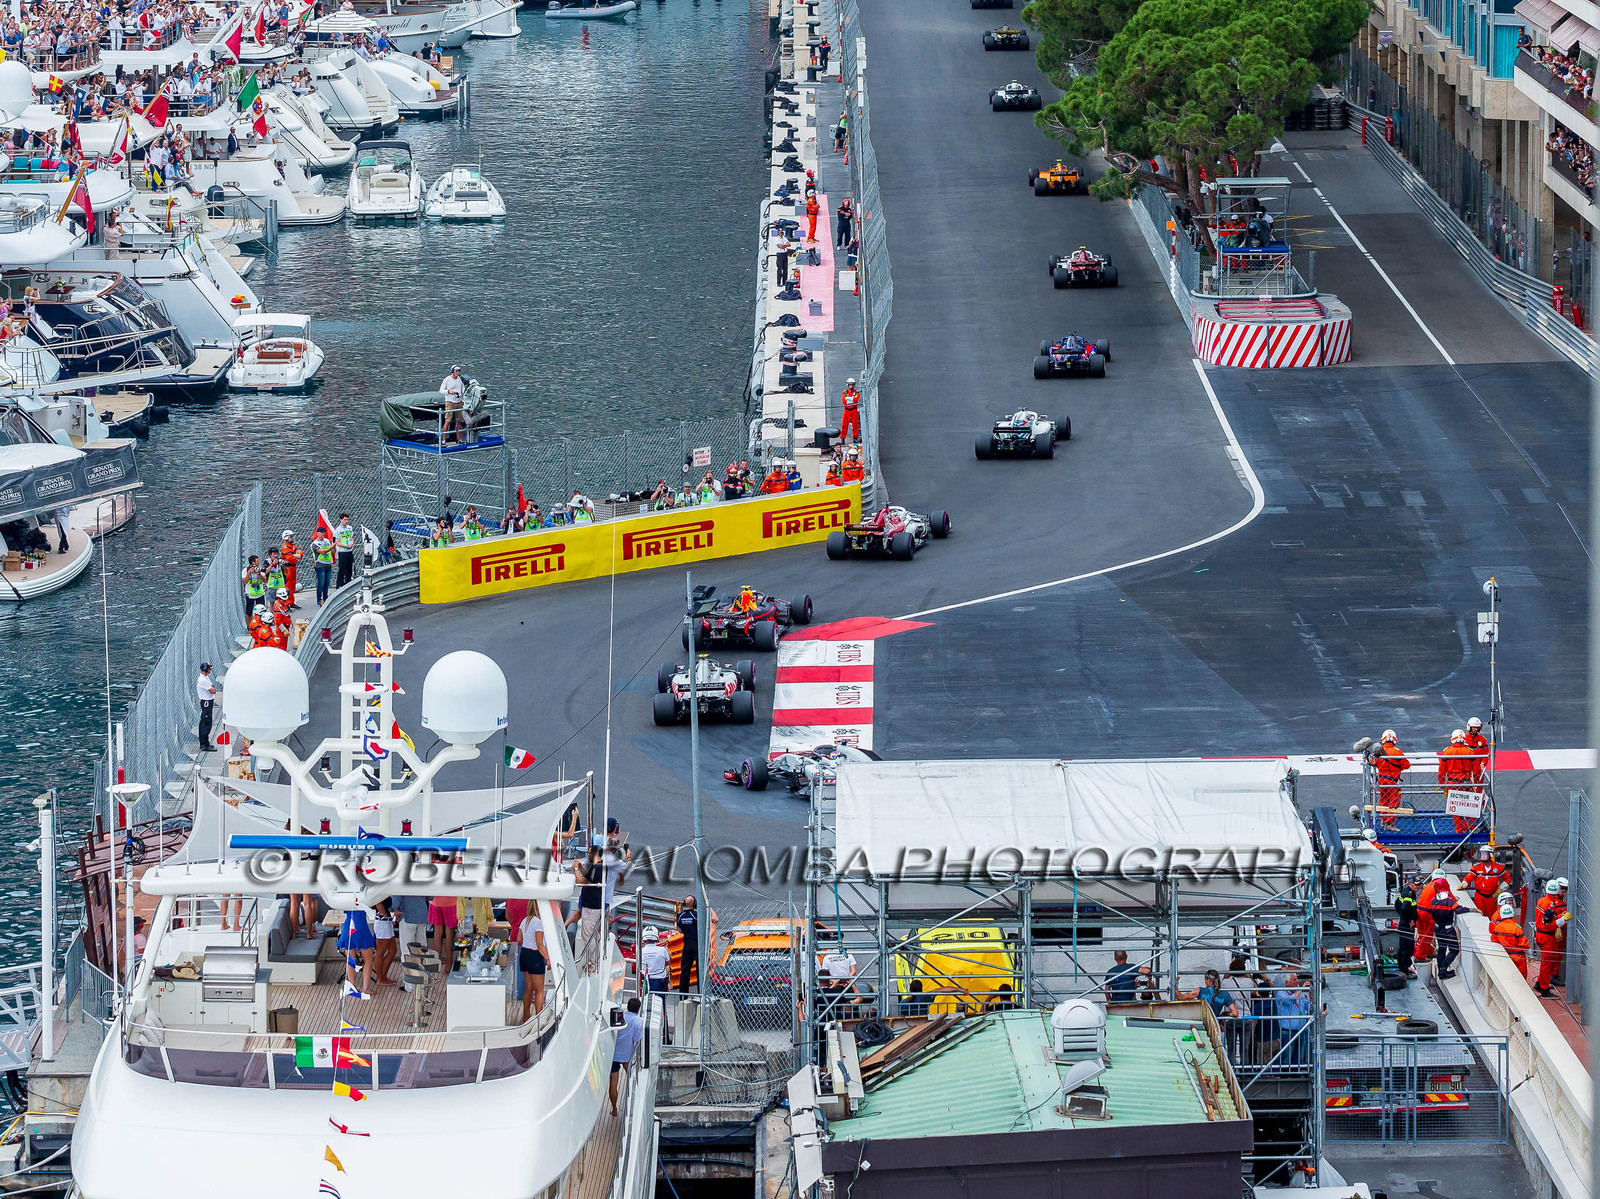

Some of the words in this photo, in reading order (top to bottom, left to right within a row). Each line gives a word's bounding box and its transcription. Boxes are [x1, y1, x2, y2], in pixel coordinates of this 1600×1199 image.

[87, 469, 106, 480] GRAND
[105, 466, 122, 476] PRIX
[92, 462, 114, 474] SENATE
[37, 482, 57, 493] GRAND
[56, 479, 72, 489] PRIX
[42, 475, 64, 486] SENATE
[7, 490, 21, 500] PRIX
[762, 499, 851, 539] PIRELLI
[622, 519, 715, 561] PIRELLI
[471, 543, 566, 586] PIRELLI
[1449, 792, 1470, 800] SECTEUR
[1449, 800, 1479, 808] INTERVENTION
